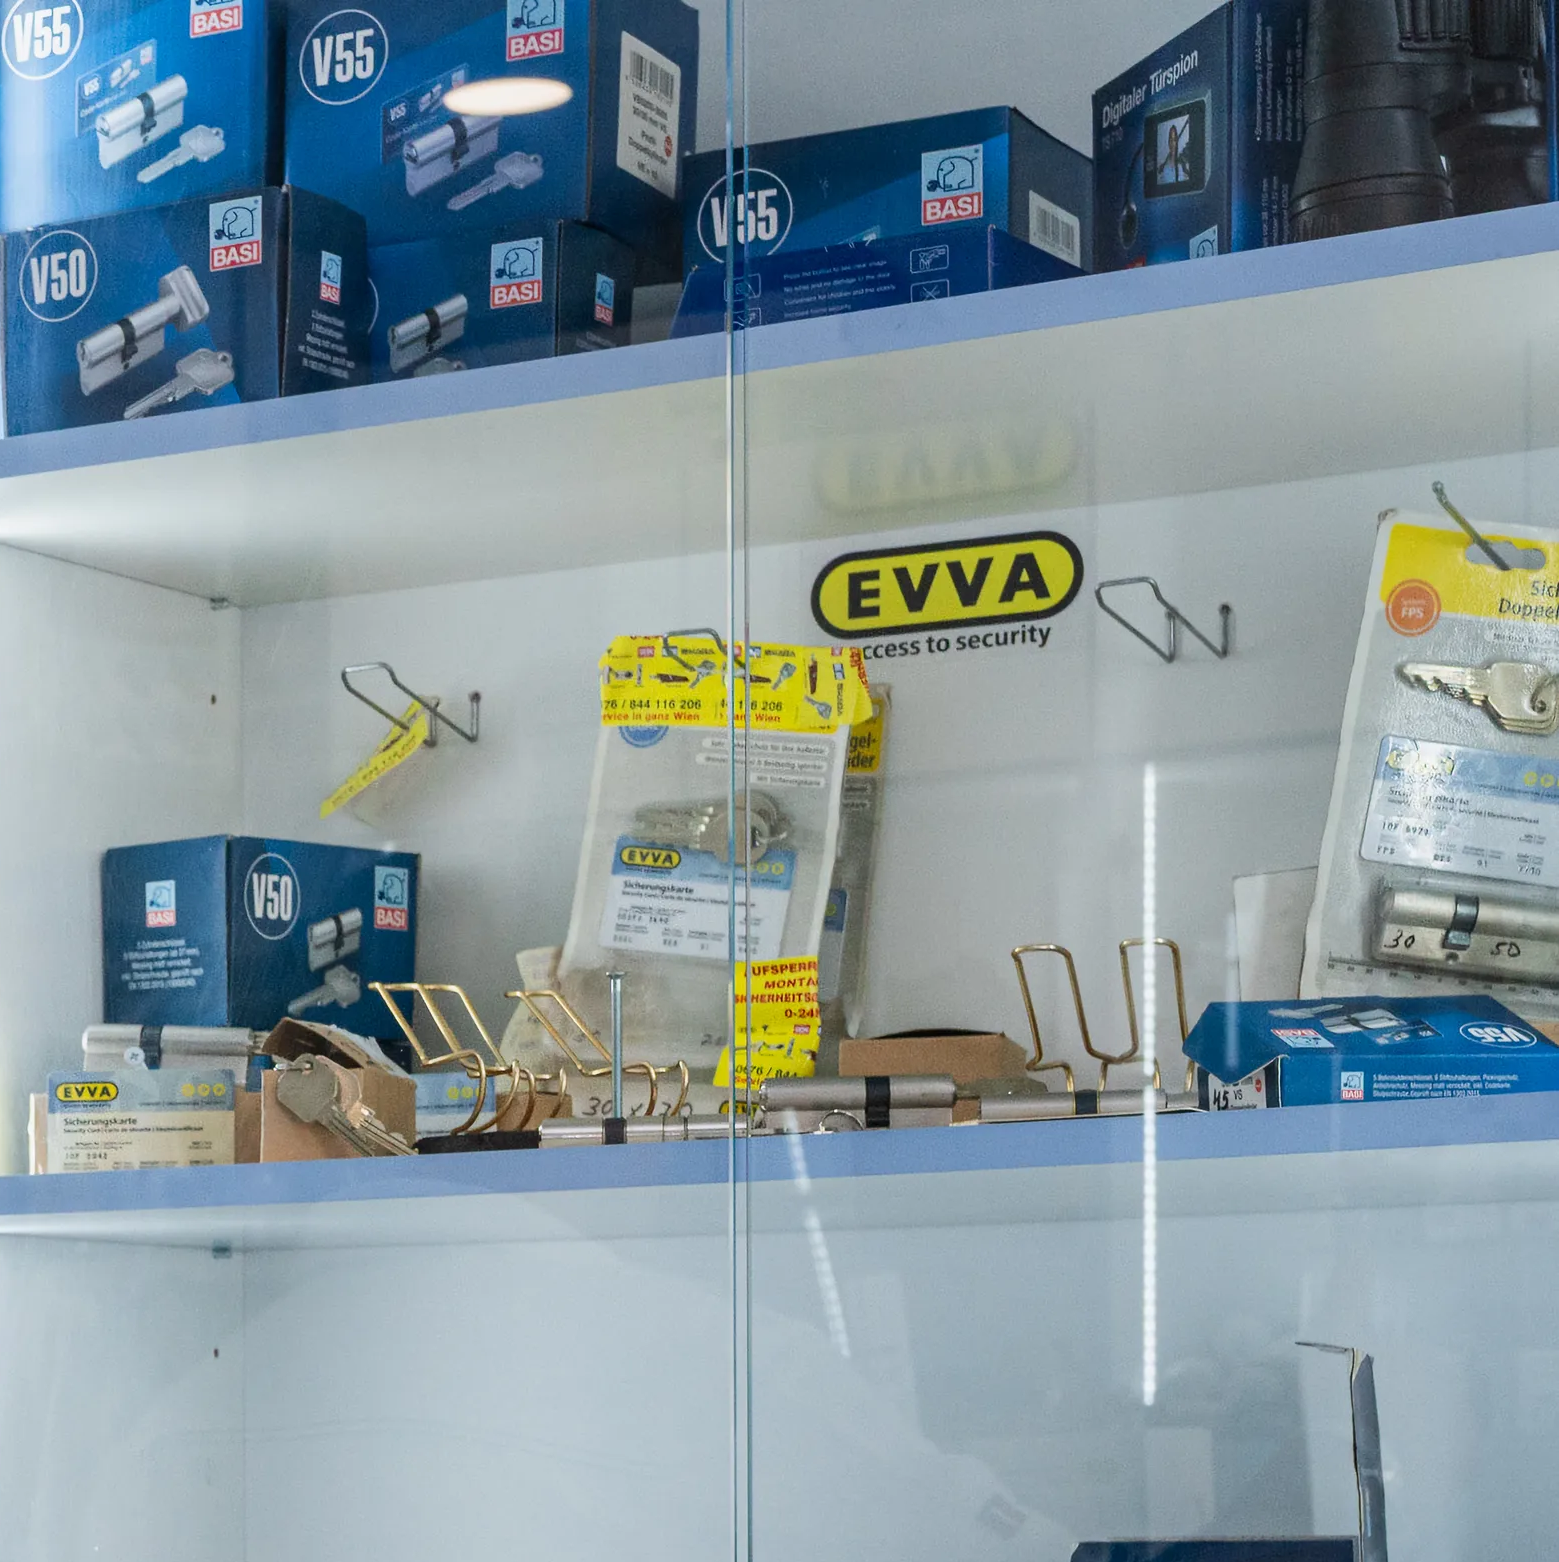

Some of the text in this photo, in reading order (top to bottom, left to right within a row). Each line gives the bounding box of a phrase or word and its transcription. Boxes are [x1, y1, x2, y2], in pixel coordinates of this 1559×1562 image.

[12, 5, 72, 64] V55
[193, 11, 240, 35] BASI
[509, 31, 561, 58] BASI
[311, 28, 376, 87] V55
[1102, 50, 1199, 129] Digitaler Türspion
[710, 189, 778, 248] V55
[924, 197, 980, 222] BASI
[213, 242, 259, 269] BASI
[31, 248, 87, 305] V50
[321, 283, 340, 302] BASI
[493, 282, 540, 306] BASI
[847, 552, 1052, 620] EVVA
[1400, 605, 1424, 620] FPS
[862, 624, 1053, 661] ccess to security
[629, 699, 651, 710] 844
[656, 699, 676, 710] 116
[680, 699, 702, 710] 206
[761, 700, 783, 711] 206
[673, 711, 701, 722] Wien
[627, 850, 674, 866] EVVA
[252, 872, 293, 921] V50
[148, 910, 175, 925] BASI
[376, 909, 406, 927] BASI
[1383, 928, 1522, 959] 30 50
[1467, 1026, 1530, 1043] V55
[63, 1085, 112, 1099] EVVA
[63, 1117, 138, 1128] Sicherungskarte
